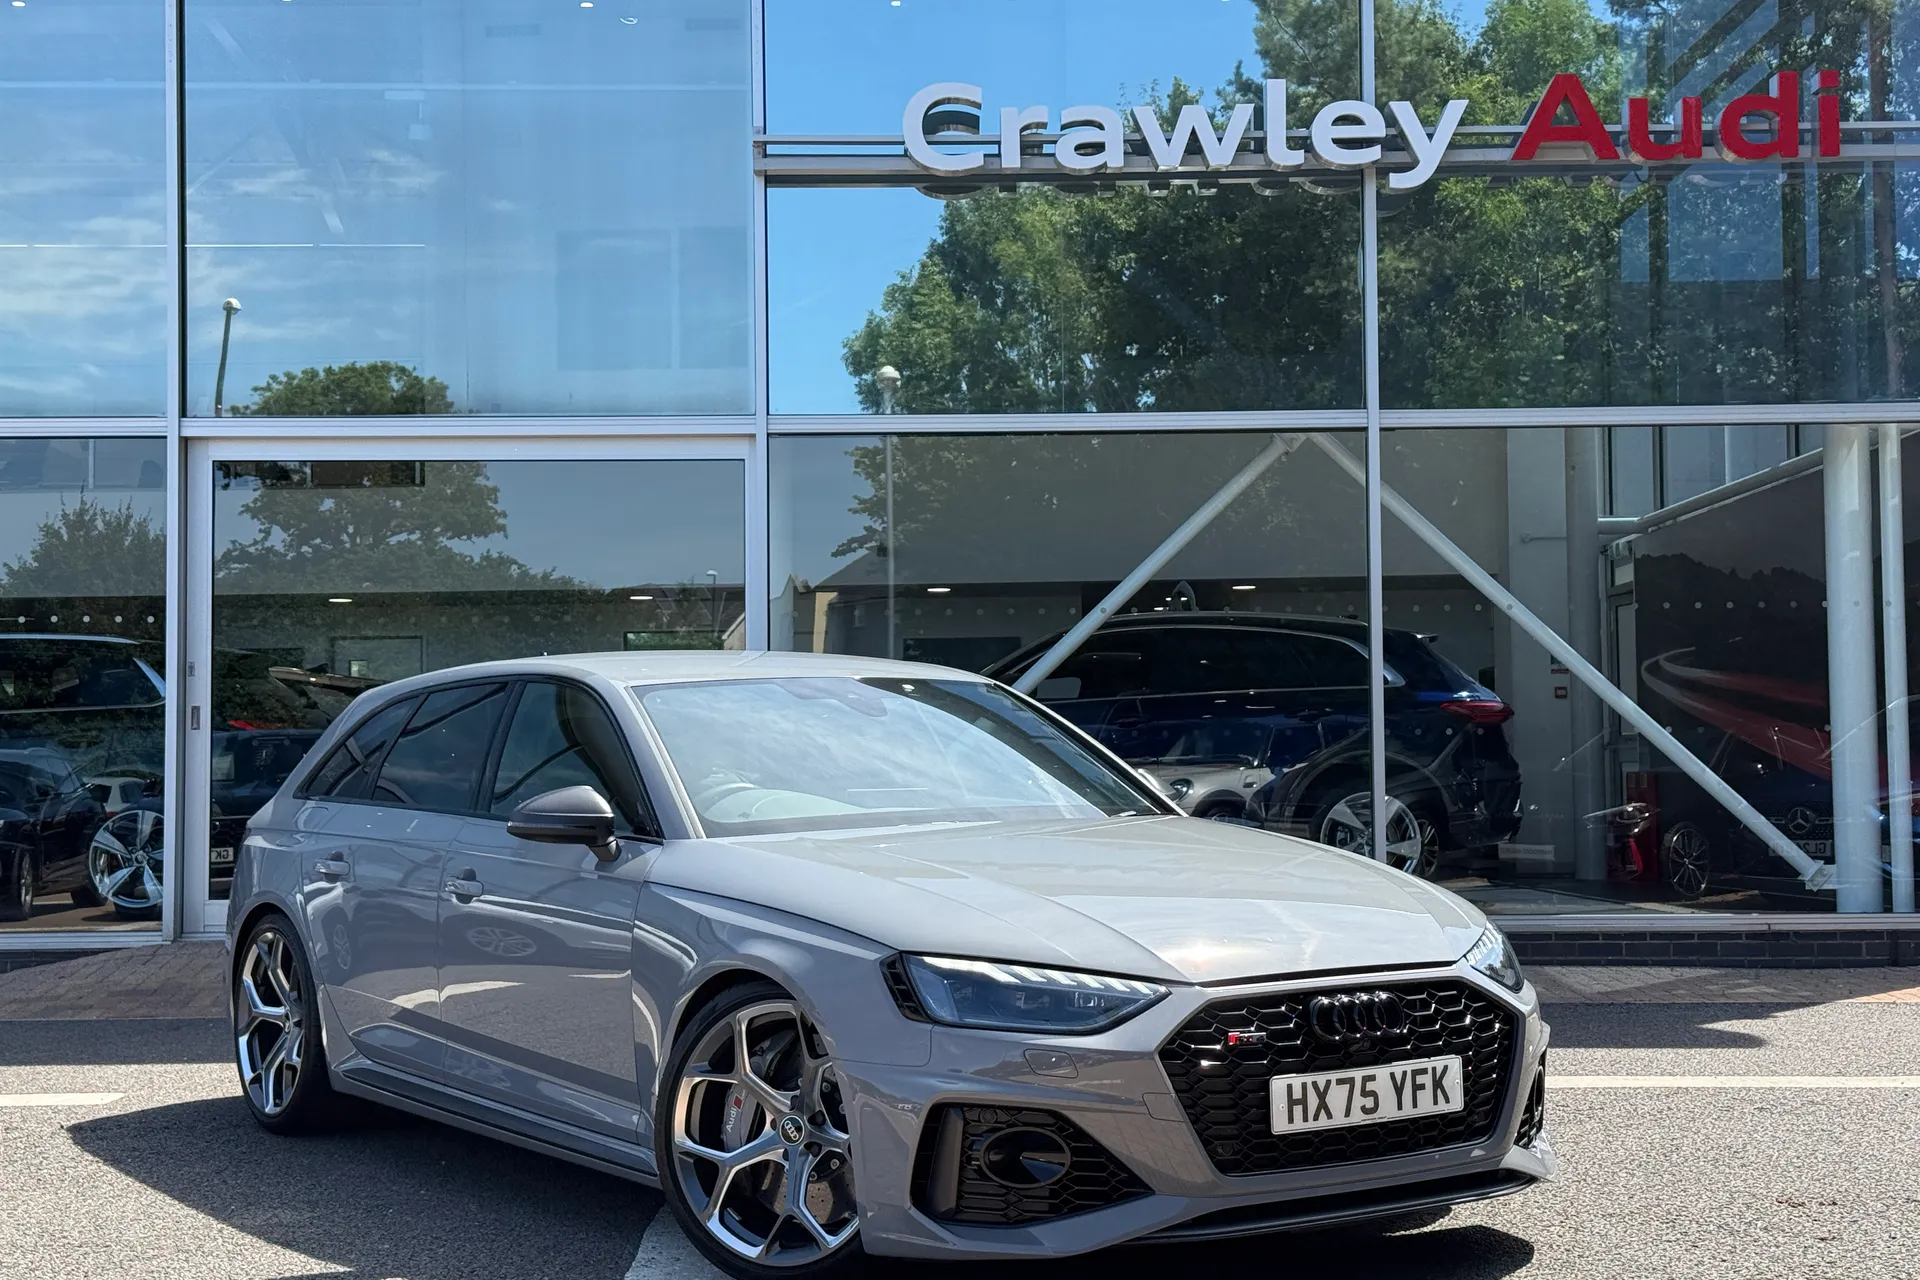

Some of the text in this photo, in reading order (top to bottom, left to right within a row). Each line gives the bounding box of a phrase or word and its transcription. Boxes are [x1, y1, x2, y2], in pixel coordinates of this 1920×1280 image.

[903, 71, 1841, 188] Crawley Audi
[726, 1107, 738, 1132] Audi
[1286, 1064, 1450, 1124] HX75 YFK
